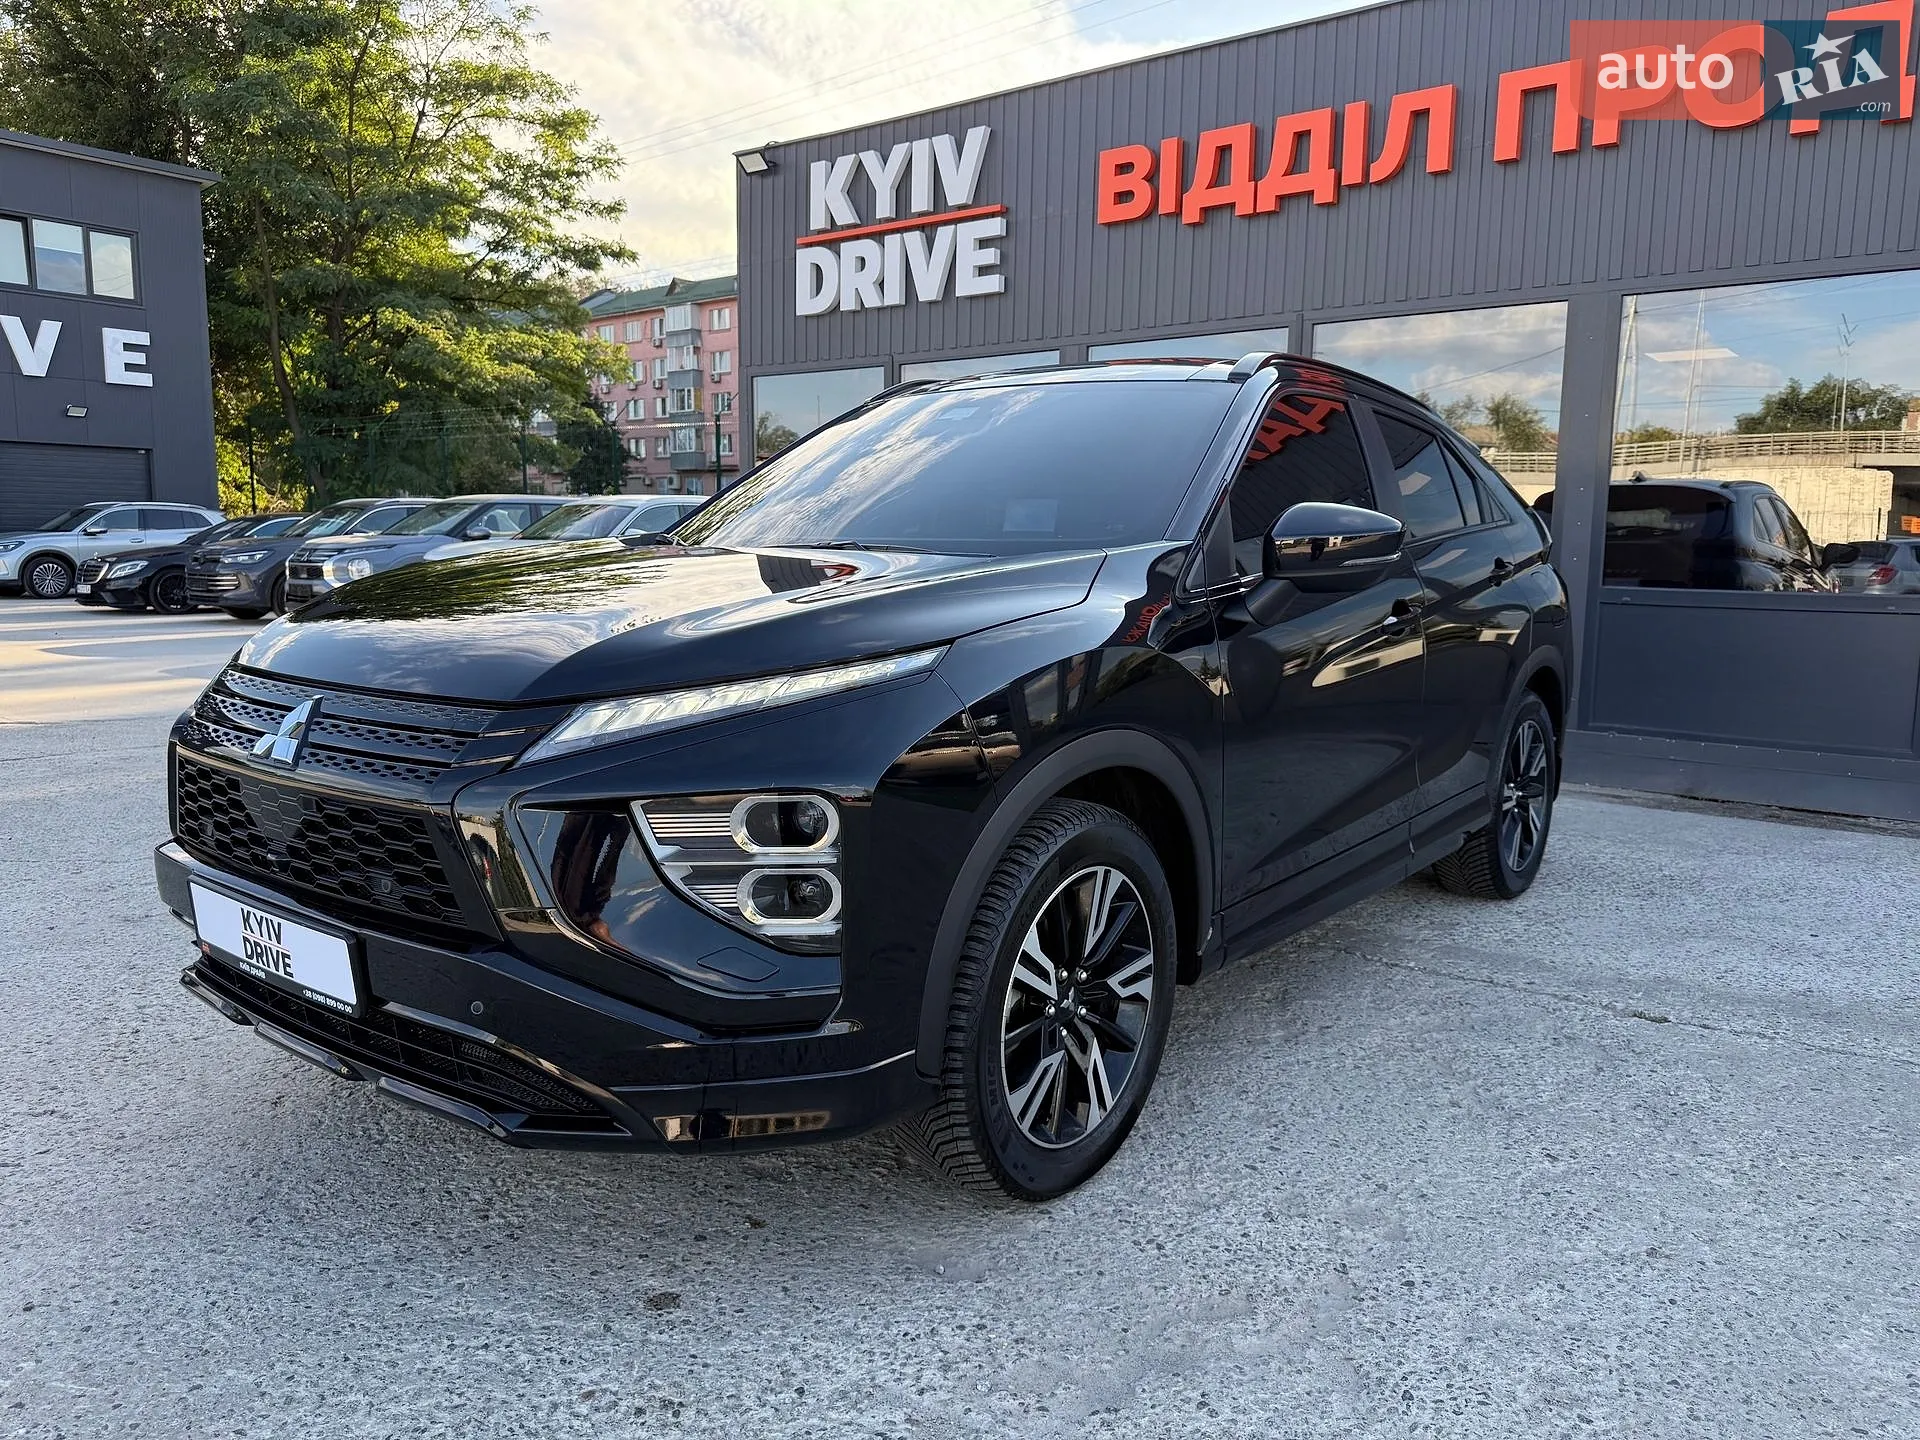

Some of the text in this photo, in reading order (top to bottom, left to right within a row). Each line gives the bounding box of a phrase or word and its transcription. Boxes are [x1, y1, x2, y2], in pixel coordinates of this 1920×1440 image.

[810, 126, 992, 230] KYIV
[1098, 85, 1456, 225] ВІДДІЛ
[796, 217, 1006, 316] DRIVE
[240, 907, 283, 945] KYIV
[242, 935, 294, 978] DRIVE
[336, 1001, 345, 1011] 00
[344, 1005, 353, 1014] 00
